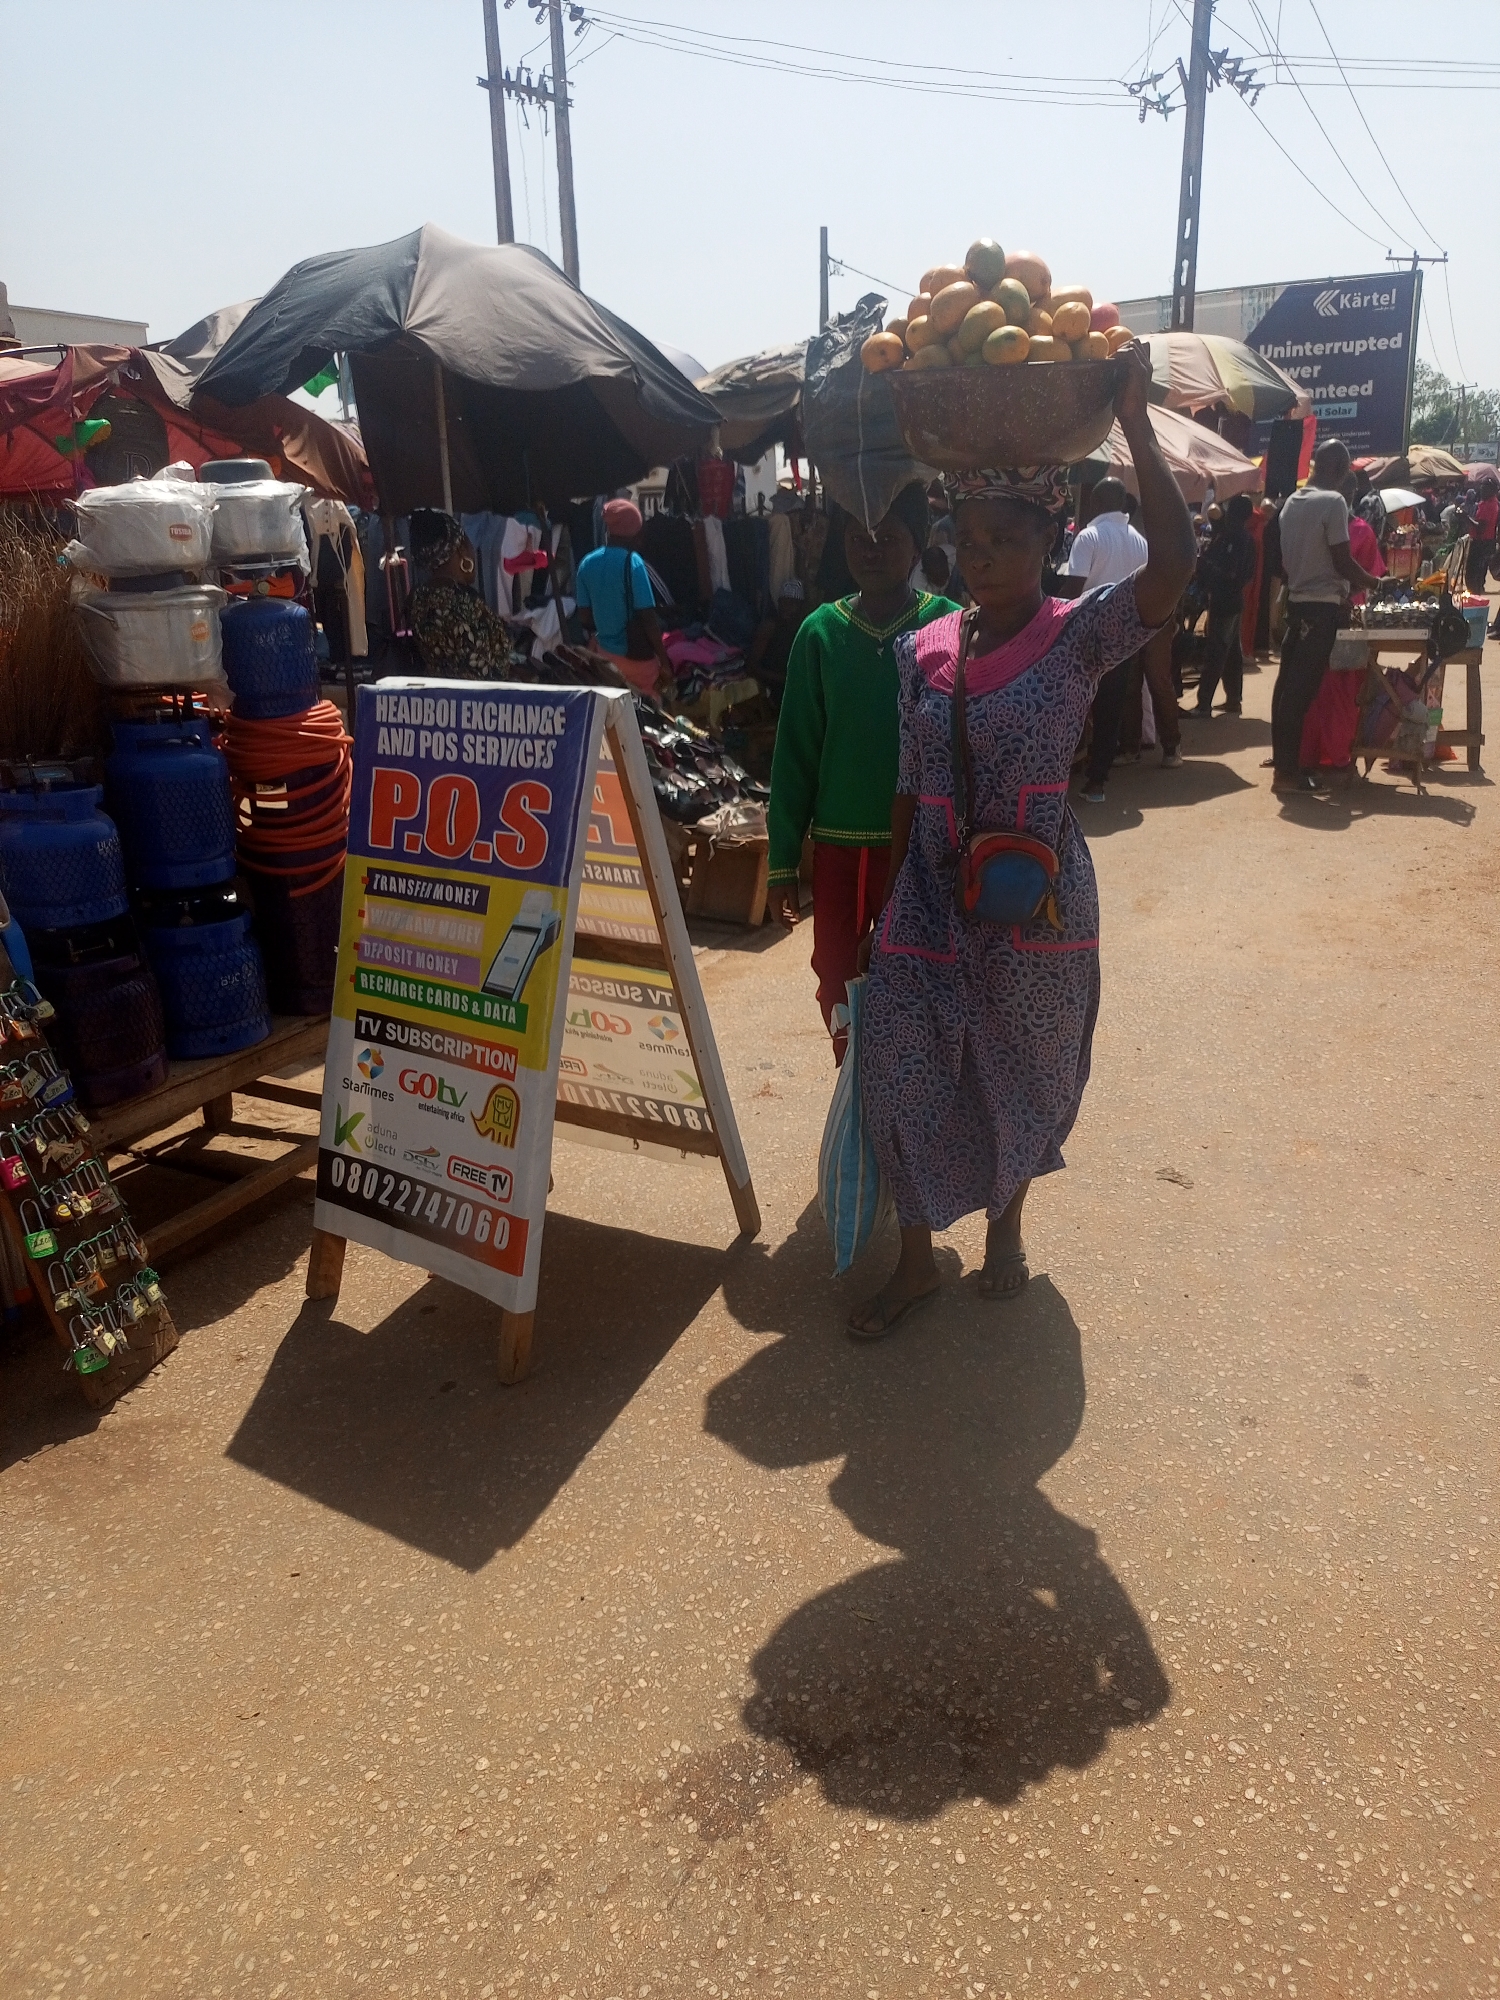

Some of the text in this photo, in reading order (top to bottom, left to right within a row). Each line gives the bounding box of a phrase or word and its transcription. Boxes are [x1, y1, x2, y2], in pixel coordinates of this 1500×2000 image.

[1340, 288, 1396, 309] Kärtel
[1259, 333, 1403, 359] Uninterrupted
[1283, 365, 1321, 379] wer
[1325, 407, 1353, 417] Solar
[376, 694, 566, 736] HEADBOI EXCHANGE
[377, 727, 557, 770] AND POS SERVICES
[368, 767, 552, 870] P.O.S
[438, 920, 481, 945] MONEY
[364, 941, 459, 976] DEPOSIT MONEY
[360, 972, 517, 1025] RECHARGE CARDS & DATA
[358, 1015, 516, 1074] TV SUBSCRIPTION
[342, 1077, 395, 1102] StarTimes
[418, 1102, 465, 1123] entertaining africa
[452, 1162, 488, 1185] FREE
[492, 1173, 508, 1192] TV
[331, 1157, 510, 1250] 08022747060
